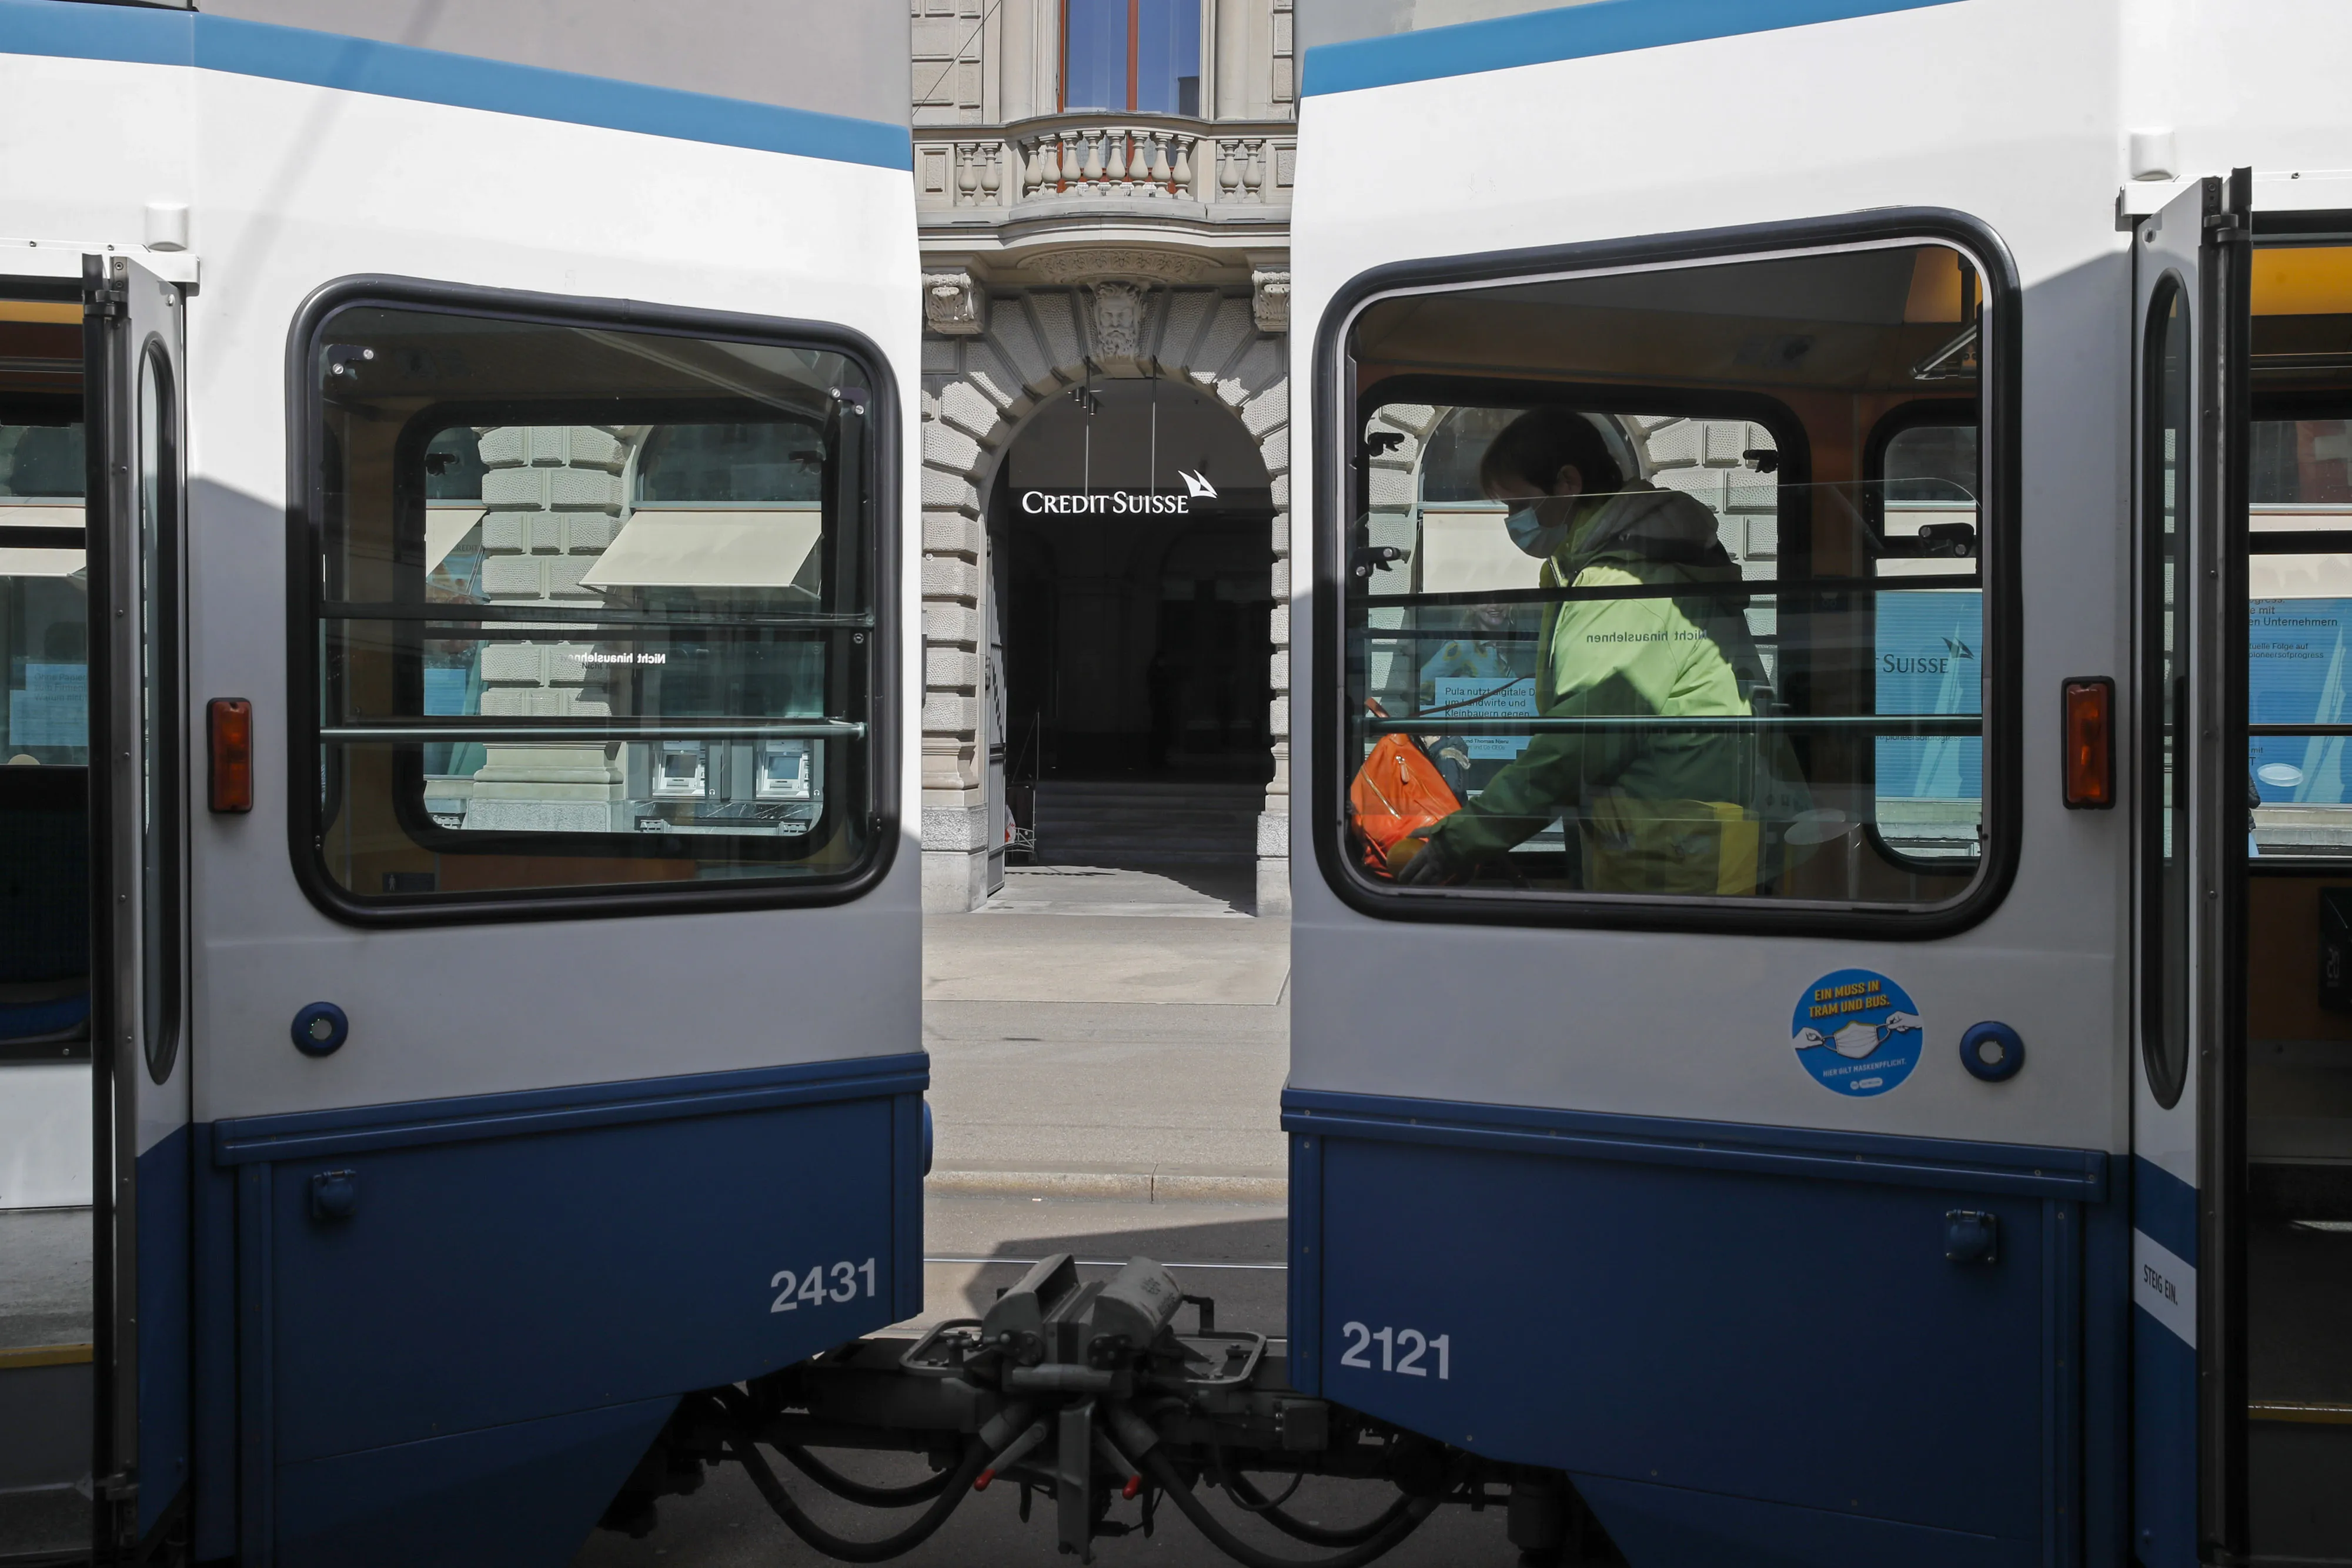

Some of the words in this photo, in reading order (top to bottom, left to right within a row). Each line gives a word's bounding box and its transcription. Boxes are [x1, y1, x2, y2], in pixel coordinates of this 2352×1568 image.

[1022, 490, 1110, 514] CREDIT
[1112, 490, 1188, 514] SUISSE
[2259, 606, 2276, 614] mit
[2264, 617, 2337, 626] Unternehmern
[1883, 654, 1949, 673] SUISSE
[1445, 709, 1498, 717] Kleinbauern
[1509, 699, 1526, 707] und
[1815, 988, 1833, 1002] EIN
[1835, 982, 1866, 998] MUSS
[1867, 980, 1881, 992] IN
[1808, 1003, 1839, 1019] TRAM
[1840, 998, 1865, 1014] UND
[1865, 994, 1891, 1009] BUS.
[1823, 1069, 1838, 1077] HIER
[1838, 1066, 1852, 1075] GILT
[1853, 1058, 1907, 1073] MASKENPFLICHT.
[770, 1257, 876, 1313] 2431
[2143, 1263, 2163, 1294] STEIG
[2164, 1279, 2178, 1306] EIN.
[1340, 1320, 1449, 1380] 2121
